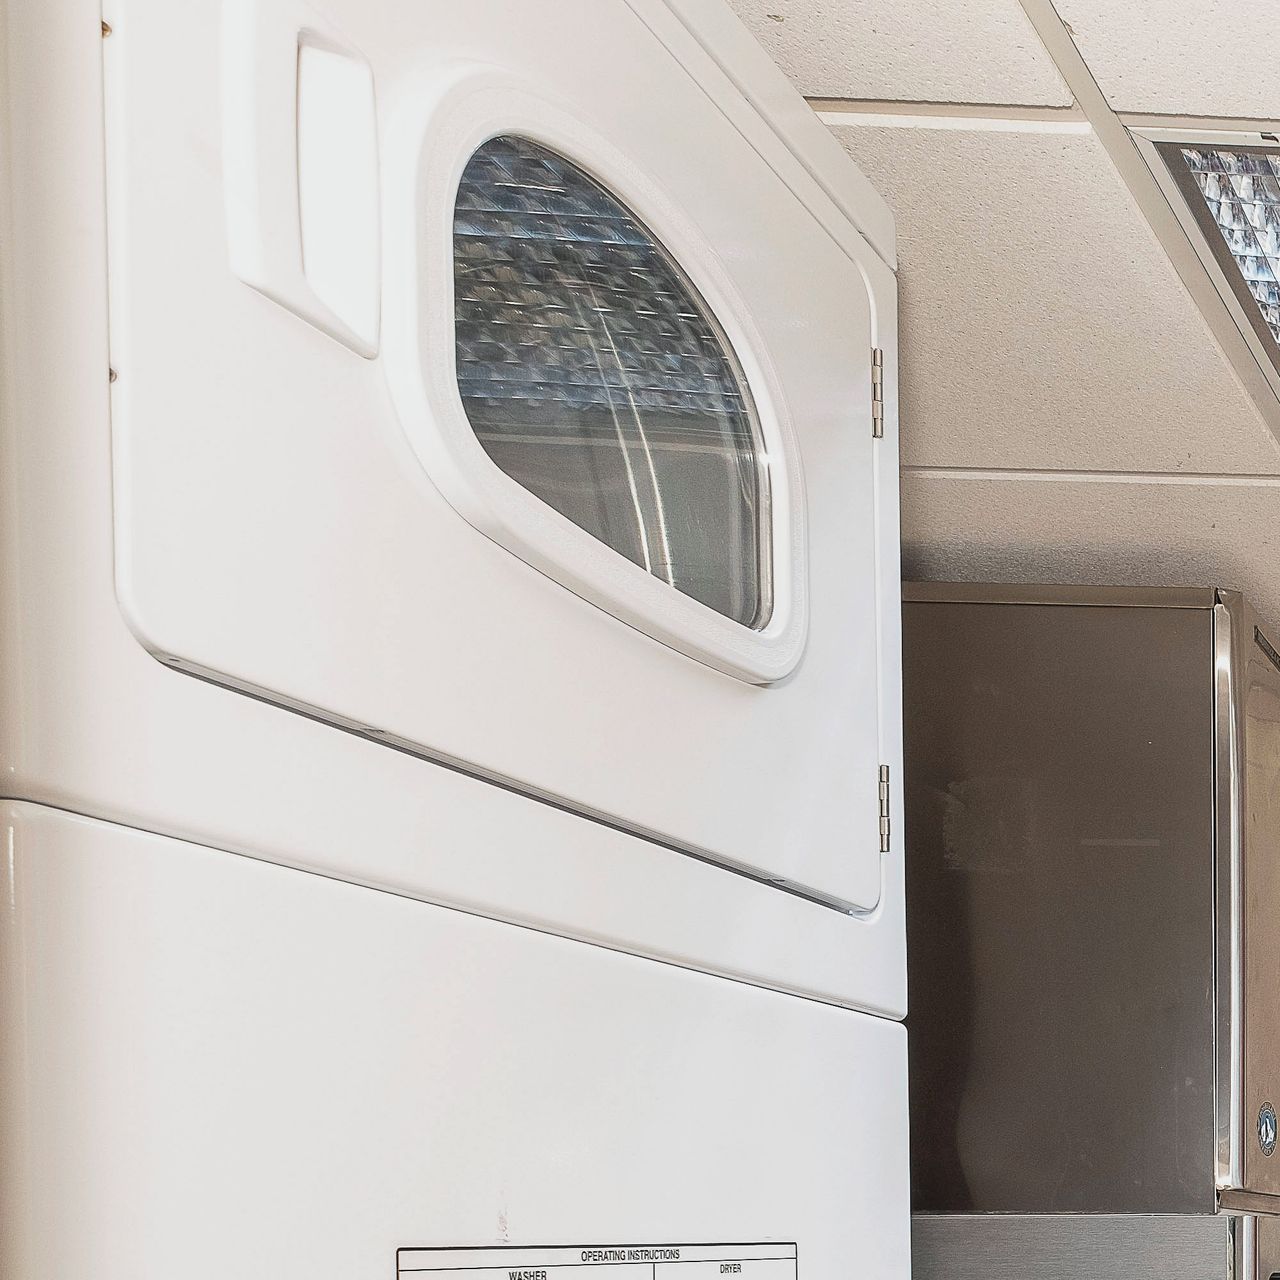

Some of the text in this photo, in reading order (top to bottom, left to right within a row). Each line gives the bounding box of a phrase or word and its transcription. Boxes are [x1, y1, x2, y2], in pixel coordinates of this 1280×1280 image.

[581, 1248, 680, 1261] OPERATING INSTRUCTIONS
[720, 1263, 741, 1274] DRYER
